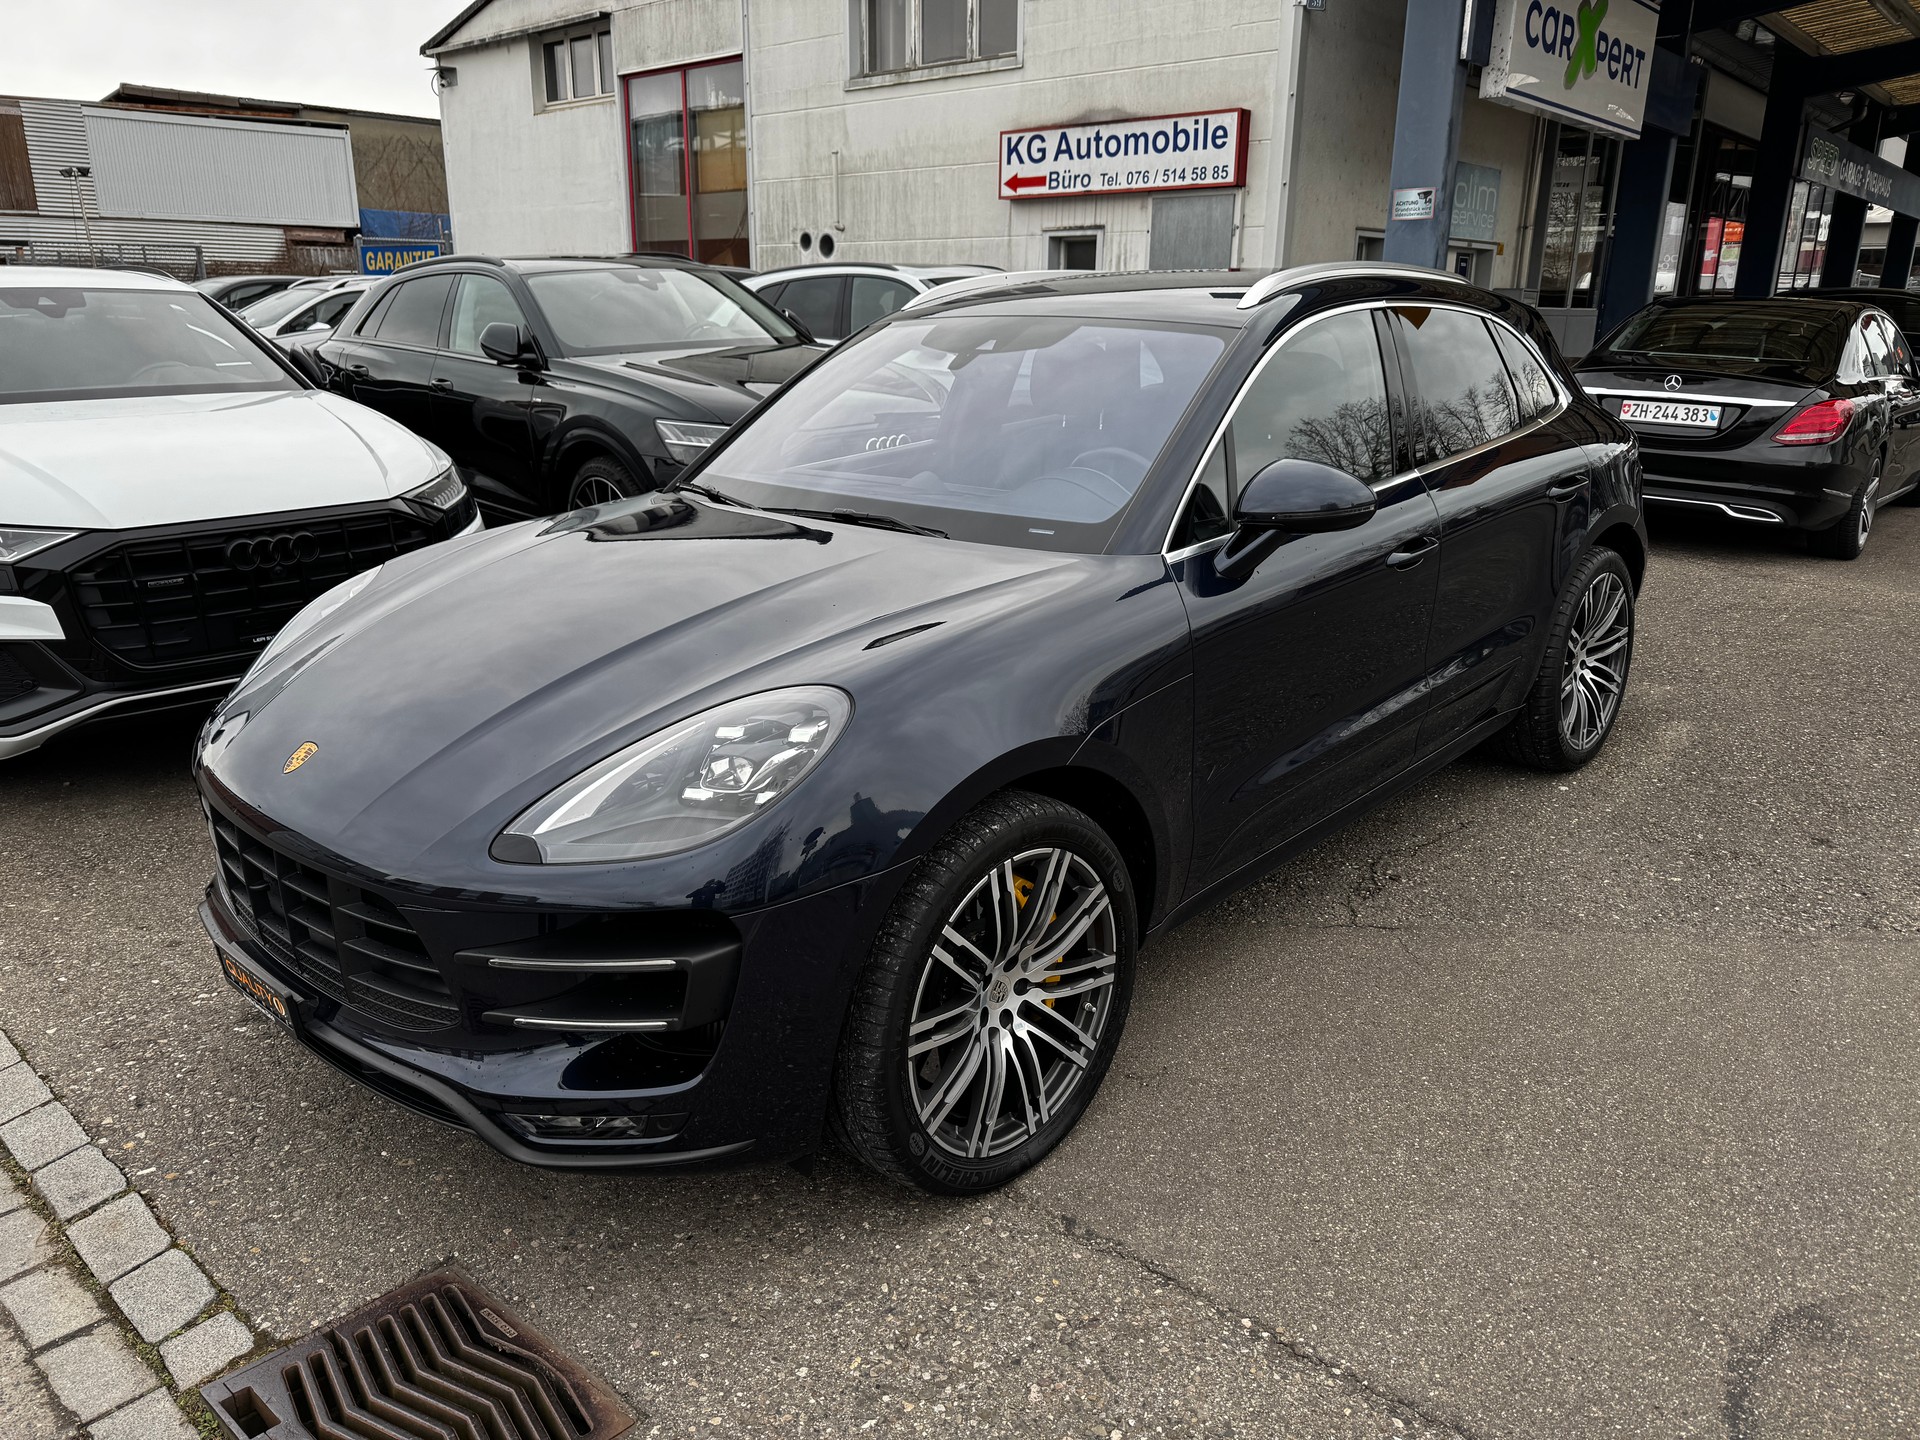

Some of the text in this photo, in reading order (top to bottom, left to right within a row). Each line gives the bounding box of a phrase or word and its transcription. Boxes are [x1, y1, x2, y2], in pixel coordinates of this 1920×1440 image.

[1006, 118, 1229, 166] KG Automobile
[1048, 169, 1092, 191] Büro
[1100, 172, 1122, 188] Tel.
[1126, 170, 1150, 185] 076
[1162, 167, 1187, 183] 514
[1191, 165, 1208, 182] 58
[1212, 164, 1229, 180] 85
[1807, 137, 1840, 177] SPEED
[1840, 158, 1864, 187] GARAGE
[1454, 173, 1498, 213] clim
[1451, 209, 1496, 229] service
[921, 1153, 1006, 1188] MICHELIN
